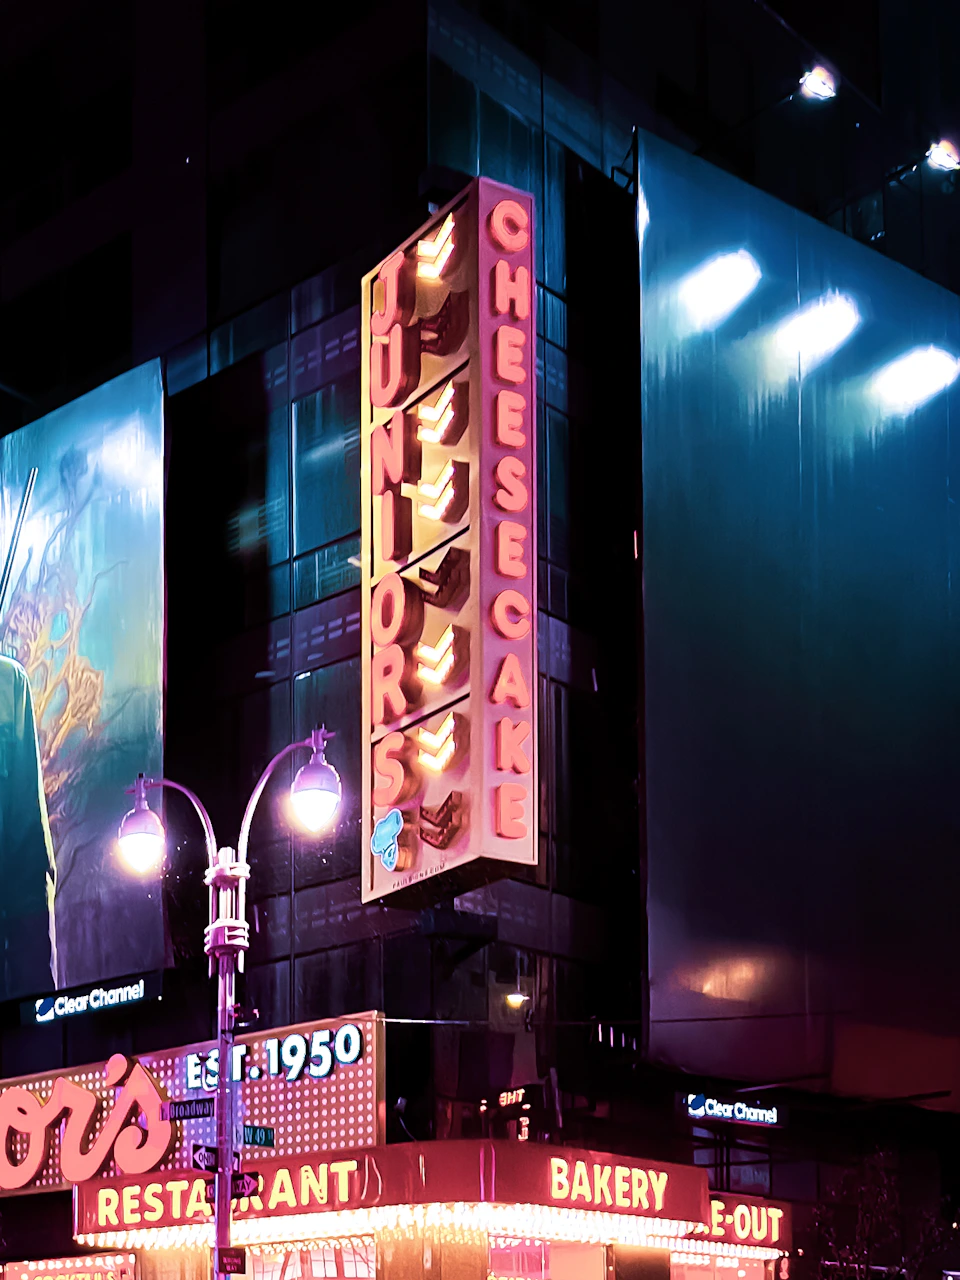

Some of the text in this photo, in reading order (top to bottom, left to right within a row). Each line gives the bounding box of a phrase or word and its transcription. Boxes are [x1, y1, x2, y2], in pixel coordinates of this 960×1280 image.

[370, 250, 406, 808] JUNIORS
[490, 198, 531, 840] CHEESECAKE
[54, 979, 145, 1016] Clear Channel
[170, 1101, 215, 1118] Broadway
[705, 1098, 778, 1124] Clear Channel
[244, 1127, 254, 1144] W
[255, 1128, 266, 1145] 49
[98, 1160, 358, 1227] RESTAANT
[550, 1157, 669, 1211] BAKERY
[711, 1200, 784, 1243] E-OUT
